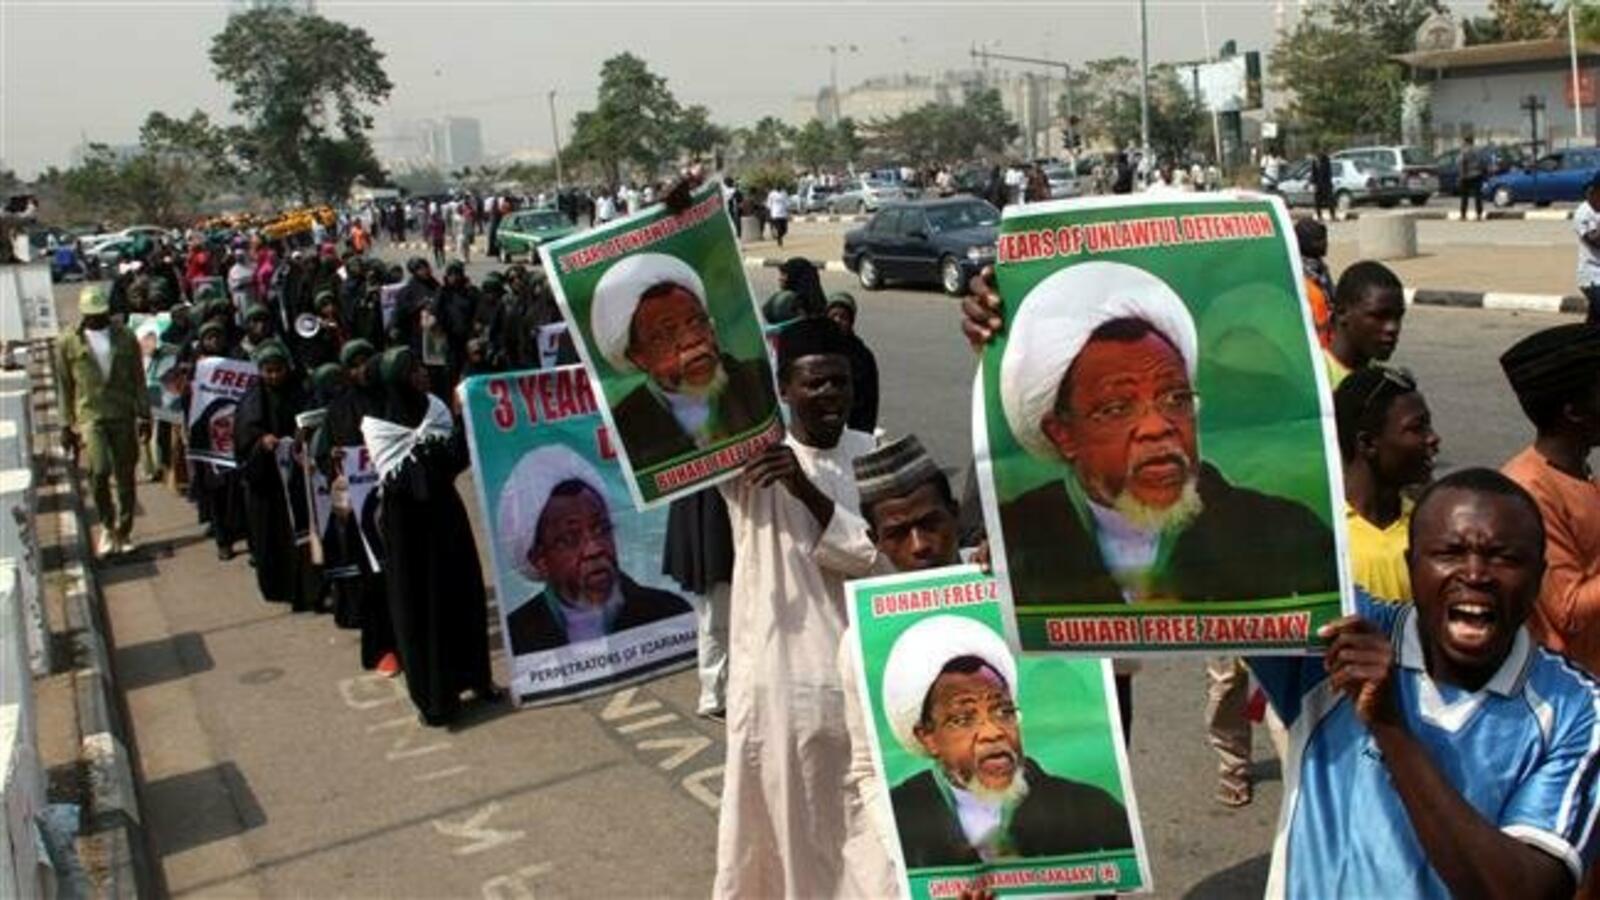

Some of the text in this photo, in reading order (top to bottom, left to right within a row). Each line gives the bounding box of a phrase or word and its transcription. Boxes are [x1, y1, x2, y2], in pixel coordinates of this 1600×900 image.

[1057, 225, 1084, 255] OF
[1084, 217, 1182, 253] UNLAWFUL
[1180, 212, 1275, 243] DETENTION
[488, 366, 600, 431] 3 YEAR
[873, 588, 941, 617] BUHARI
[942, 581, 985, 606] FREE
[1047, 612, 1311, 643] BUHARI FREE ZAKZAKY
[622, 644, 638, 661] OF
